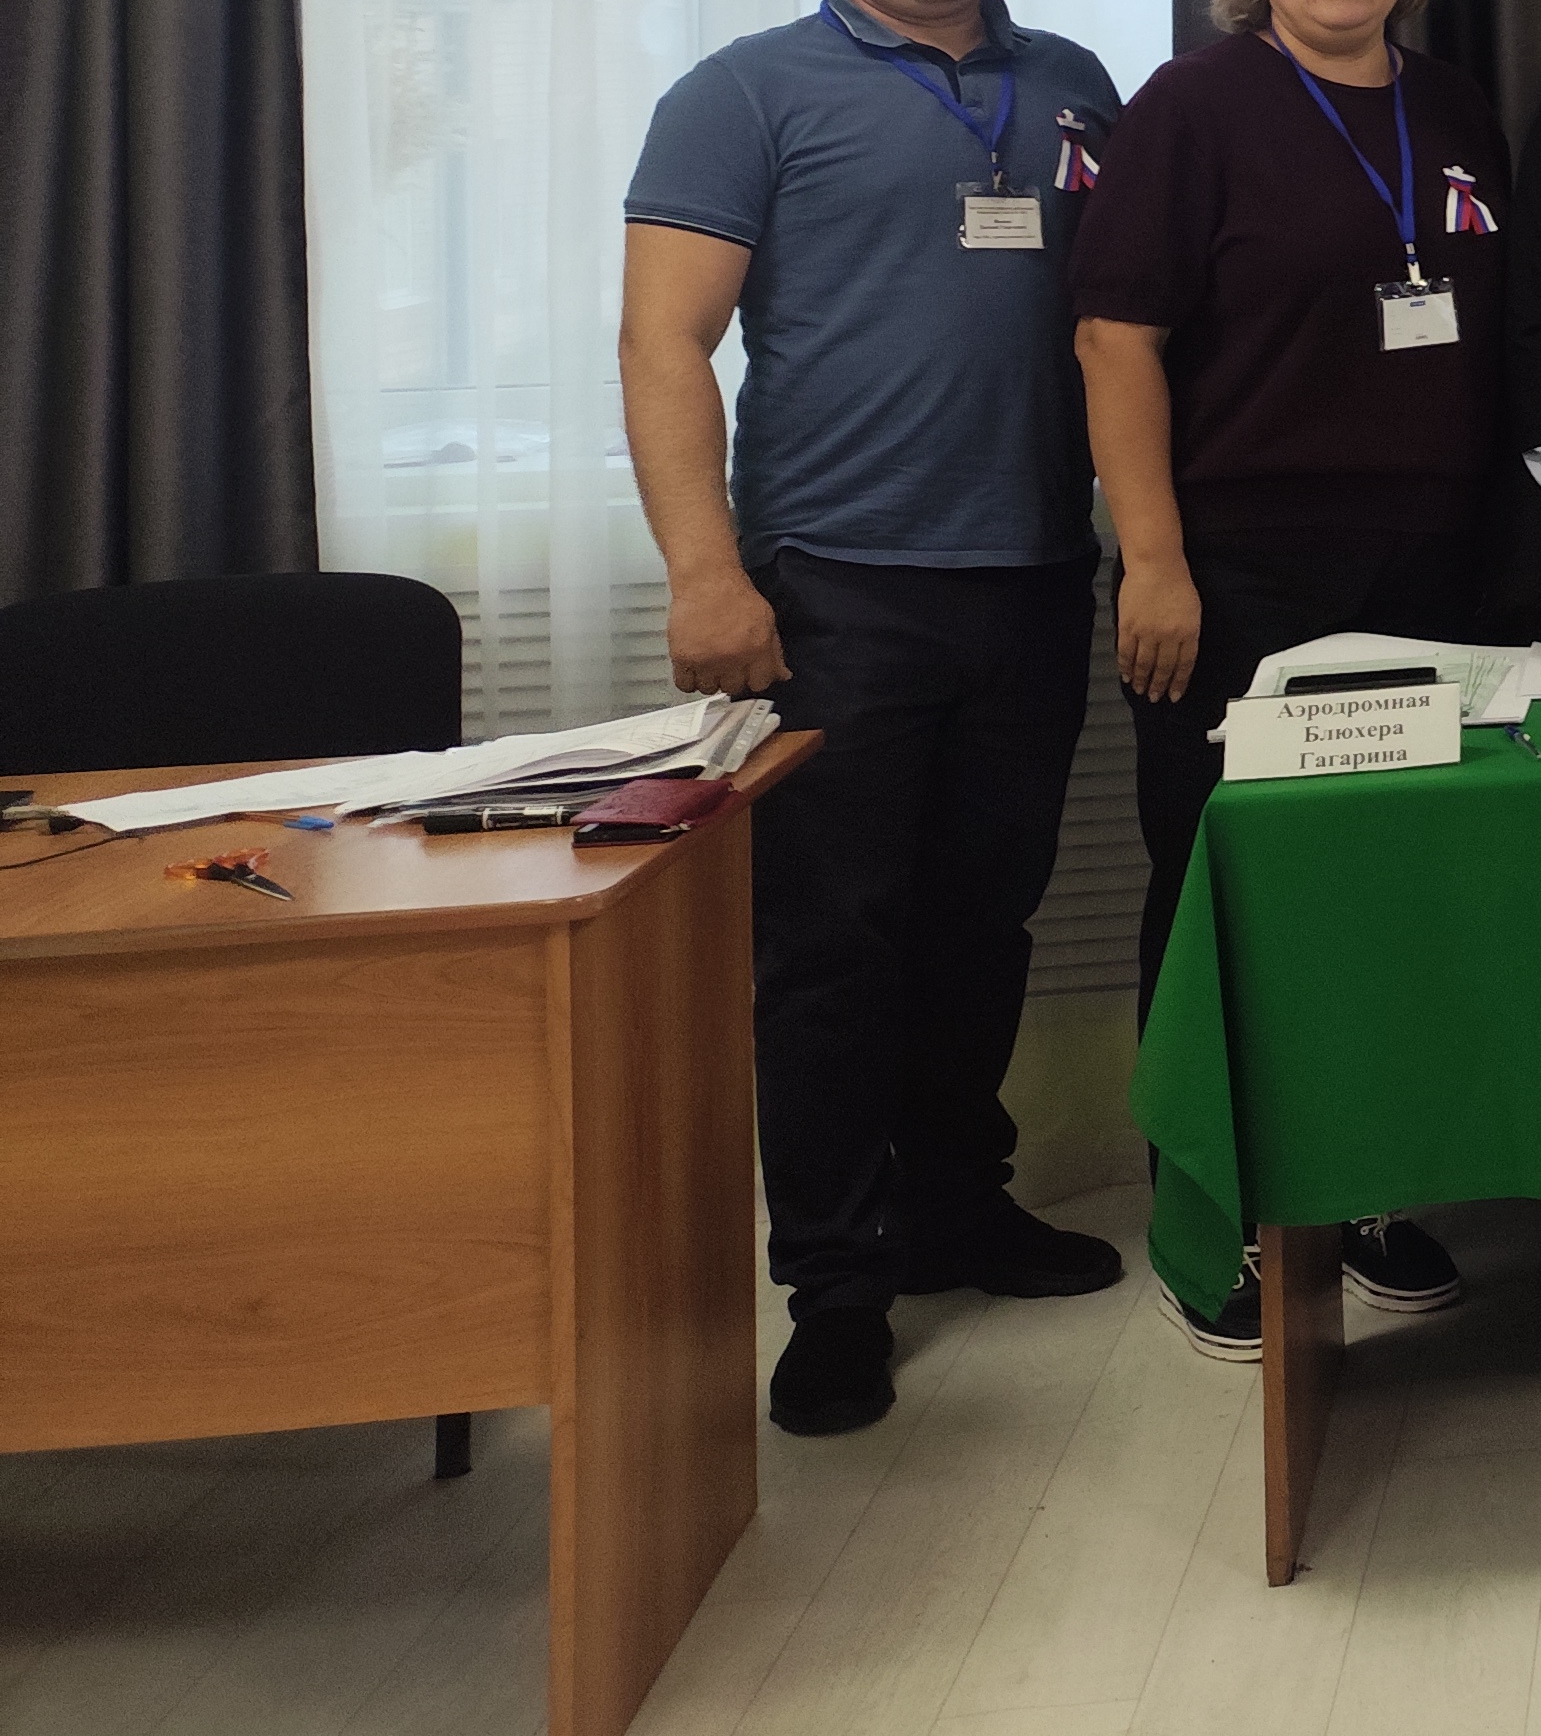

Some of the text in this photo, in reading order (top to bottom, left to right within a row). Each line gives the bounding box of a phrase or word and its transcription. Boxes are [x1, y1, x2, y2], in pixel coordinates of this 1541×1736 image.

[1276, 694, 1431, 721] Аэродромная
[1304, 723, 1404, 743] Блюхера
[1299, 748, 1408, 770] Гагарина
